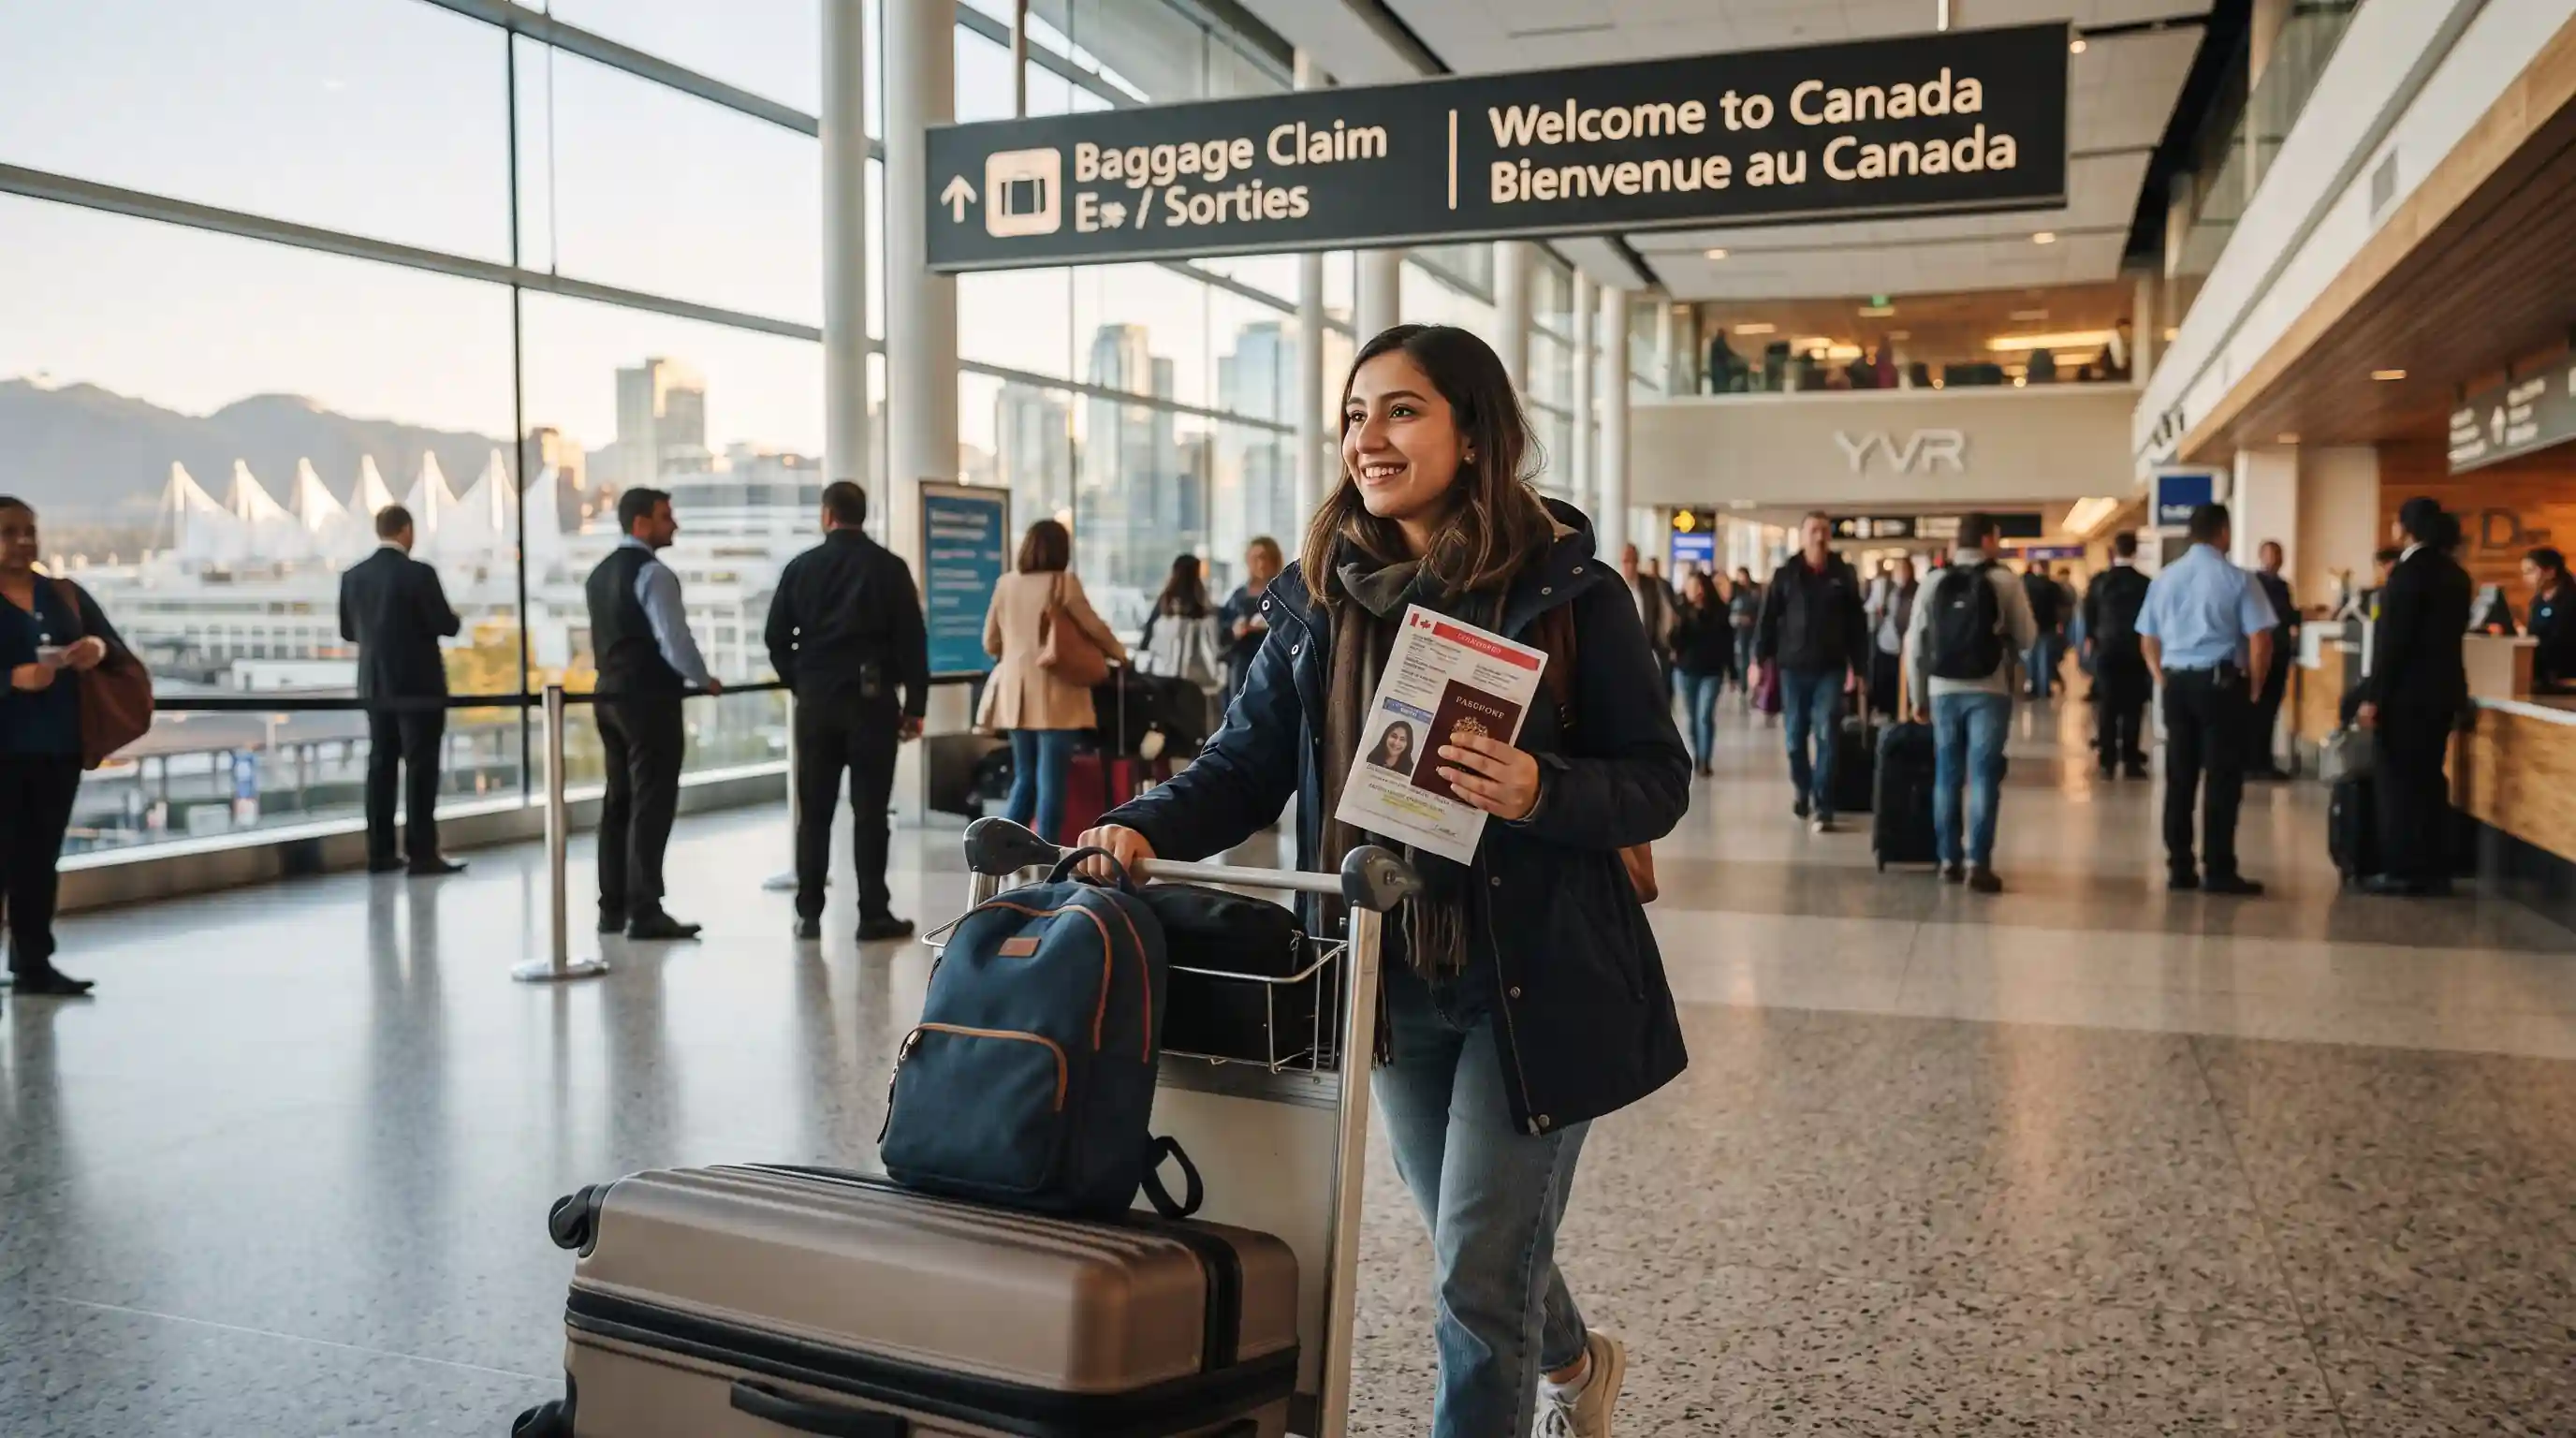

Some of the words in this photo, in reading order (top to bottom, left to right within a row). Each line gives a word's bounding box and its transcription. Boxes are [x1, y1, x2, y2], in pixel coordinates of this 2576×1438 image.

[1487, 98, 1706, 148] Welcome
[1720, 90, 1774, 131] to
[1790, 66, 1983, 125] Canada
[1075, 138, 1254, 189] Baggage
[1266, 119, 1387, 167] Claim
[1491, 155, 1732, 204] Bienvenue
[1746, 150, 1807, 187] au
[1822, 124, 2017, 181] Canada
[1164, 178, 1310, 227] Sorties
[1833, 428, 1964, 473] YVR
